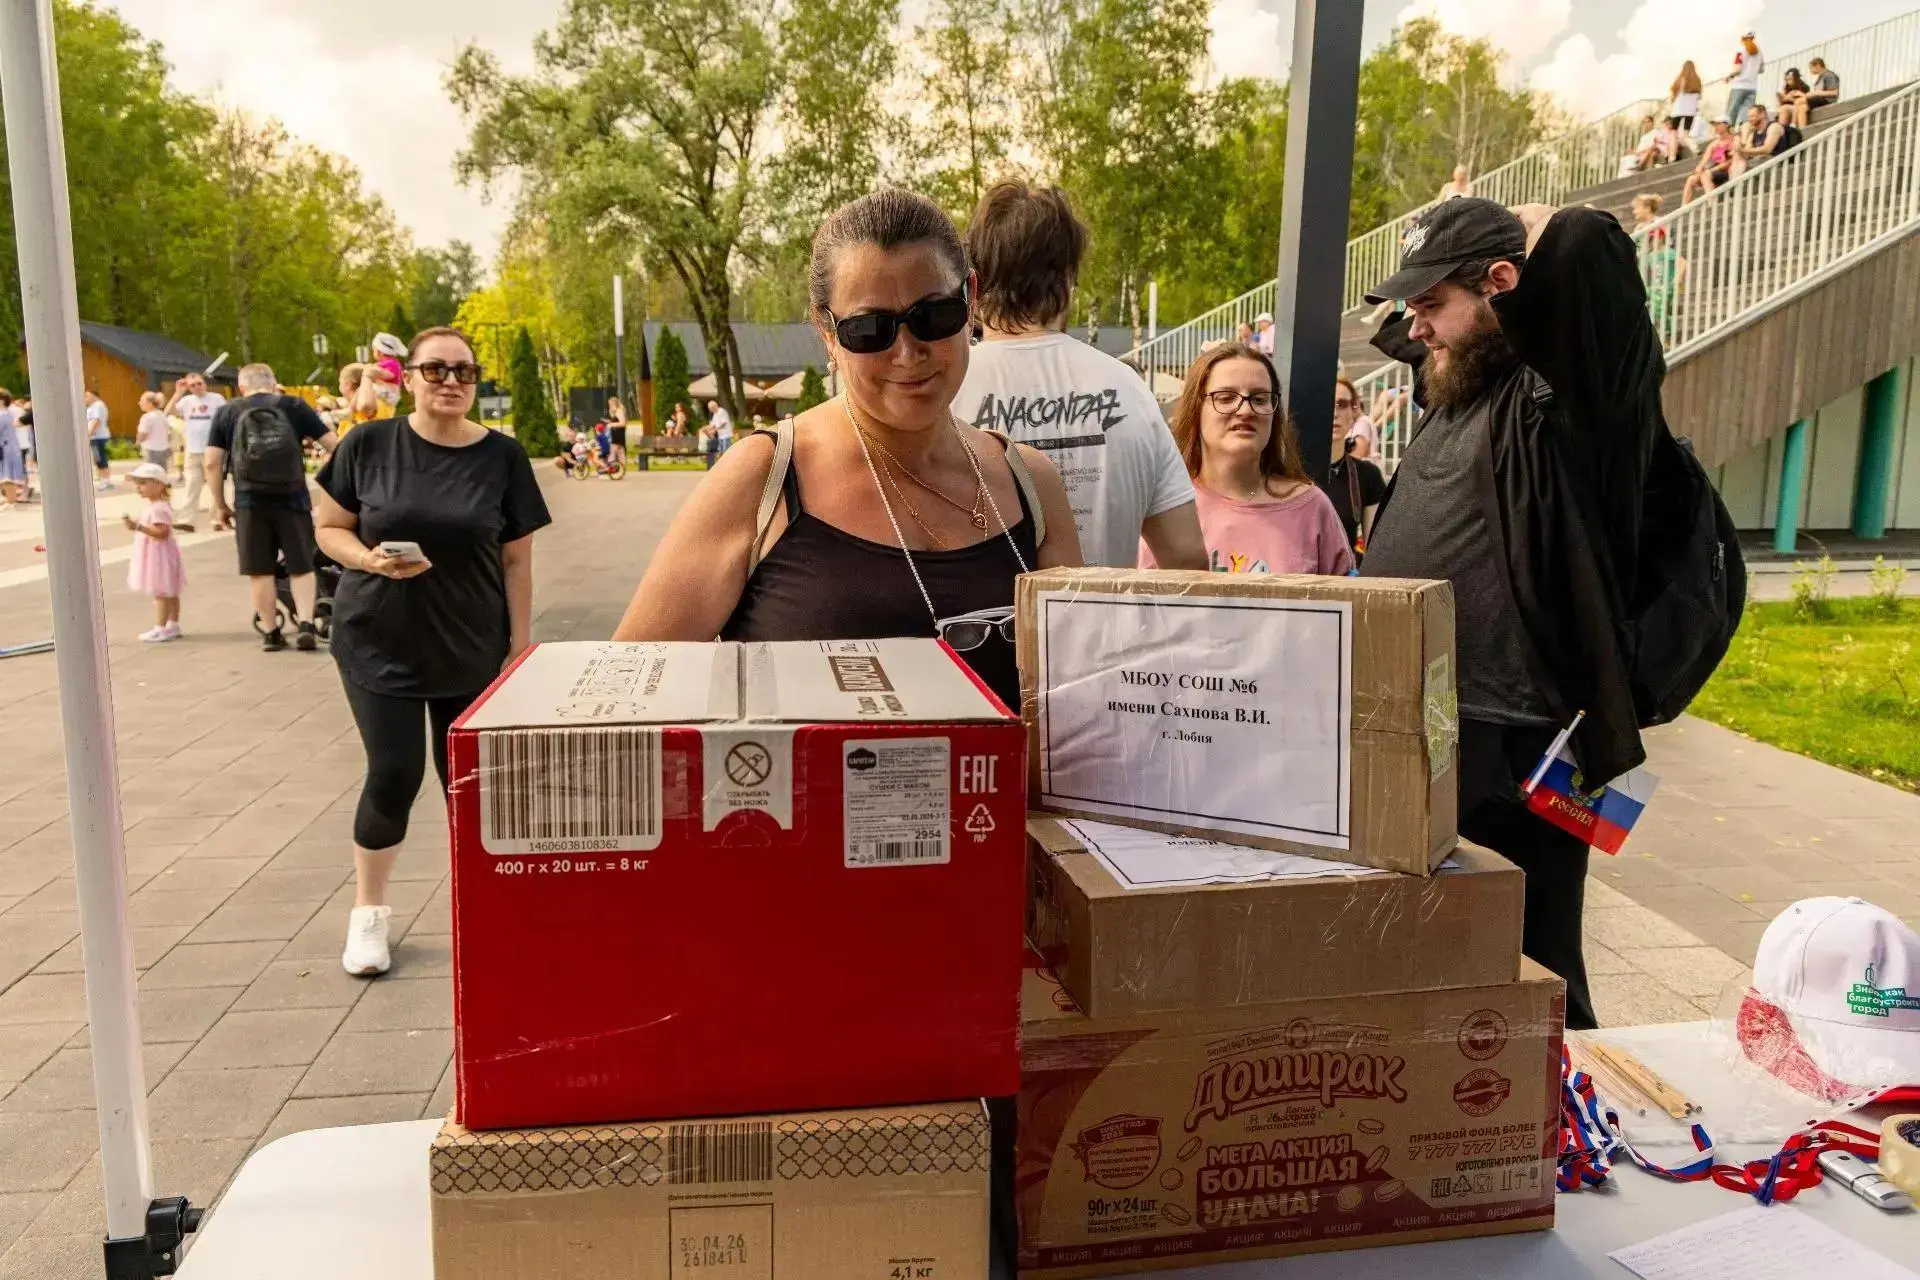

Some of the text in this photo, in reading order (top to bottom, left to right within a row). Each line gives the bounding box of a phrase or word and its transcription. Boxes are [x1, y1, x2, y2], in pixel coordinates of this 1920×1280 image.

[971, 389, 1128, 434] ANACONDAZ
[1120, 670, 1258, 694] МБОУ СОШ №6
[1108, 701, 1271, 725] имени Сахнова В.И.
[1162, 730, 1213, 744] г. Лобня
[959, 754, 999, 794] EAC
[1548, 795, 1594, 826] РОССИЯ
[915, 829, 941, 840] 2954
[973, 833, 987, 843] PAP
[530, 839, 618, 851] 14606038108362
[494, 861, 524, 875] 400
[528, 863, 535, 874] г
[552, 859, 571, 873] 20
[575, 861, 600, 872] шт.
[620, 858, 629, 870] 8
[634, 858, 649, 870] кг
[1848, 992, 1920, 1007] благоустроить
[1855, 984, 1905, 998] Знаю, как
[1853, 1004, 1887, 1015] город
[1183, 1050, 1408, 1132] Доширак
[1246, 1120, 1316, 1132] приготовления
[1409, 1122, 1537, 1144] ПРИЗОВОЙ ФОНД БОЛЕЕ
[1207, 1135, 1351, 1166] МЕГА АКЦИЯ
[1408, 1134, 1536, 1160] 7 777 777 РУБ
[1455, 1158, 1504, 1171] ИЗГОТОВЛЕНО
[1511, 1155, 1539, 1165] РОССИИ
[1201, 1156, 1358, 1194] БОЛЬШАЯ
[1203, 1188, 1321, 1225] УДАЧА!
[680, 1234, 745, 1252] 30.04.26
[890, 1266, 933, 1280] 4,1 кг
